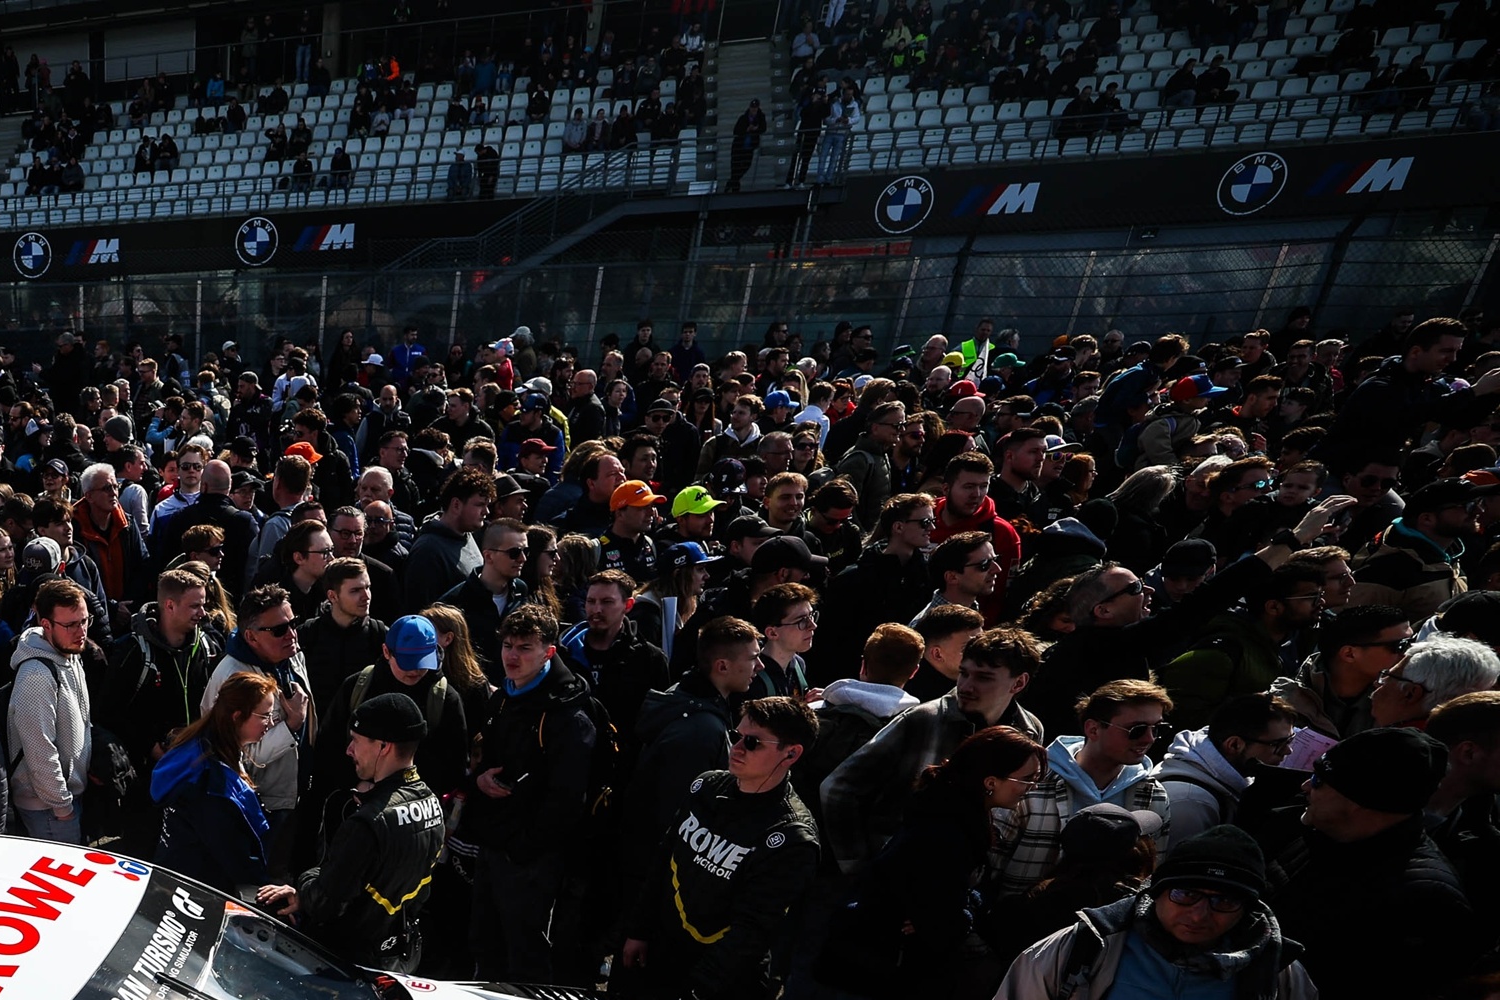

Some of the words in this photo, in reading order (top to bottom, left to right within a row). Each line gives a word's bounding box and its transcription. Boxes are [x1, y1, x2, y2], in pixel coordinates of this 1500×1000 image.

[1346, 156, 1416, 194] M
[987, 181, 1041, 215] M
[88, 238, 120, 265] M
[318, 223, 356, 251] M
[394, 797, 441, 826] ROWE
[678, 811, 752, 872] ROWE
[155, 967, 181, 1000] DRING
[174, 930, 199, 969] SIMULATOR
